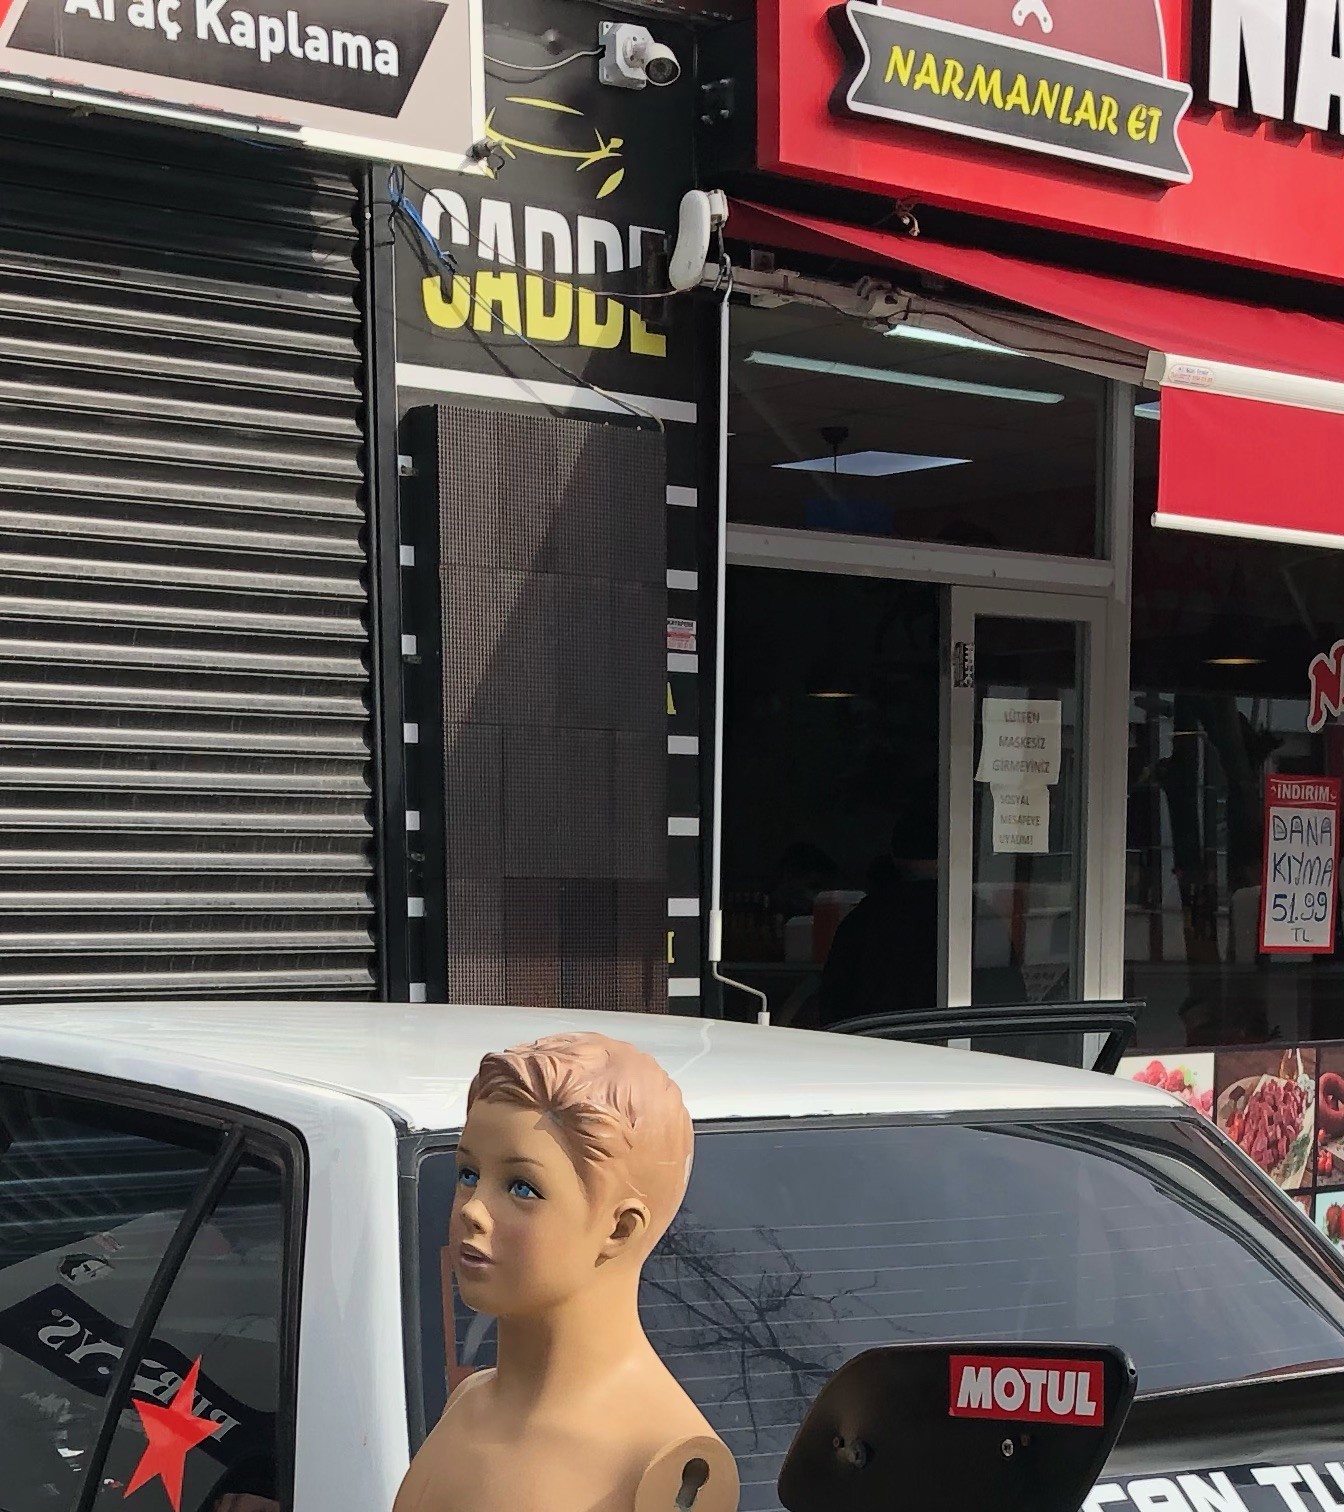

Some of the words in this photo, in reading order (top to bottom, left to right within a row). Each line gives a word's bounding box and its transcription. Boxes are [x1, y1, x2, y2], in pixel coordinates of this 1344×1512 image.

[195, 0, 400, 77] Kaplama
[884, 45, 1119, 136] NARMANLAR
[1125, 104, 1163, 145] ET
[1272, 815, 1333, 847] DANA
[1272, 851, 1334, 887] KIYMA
[1271, 891, 1328, 924] 51.99
[956, 1364, 1097, 1417] MOTUL
